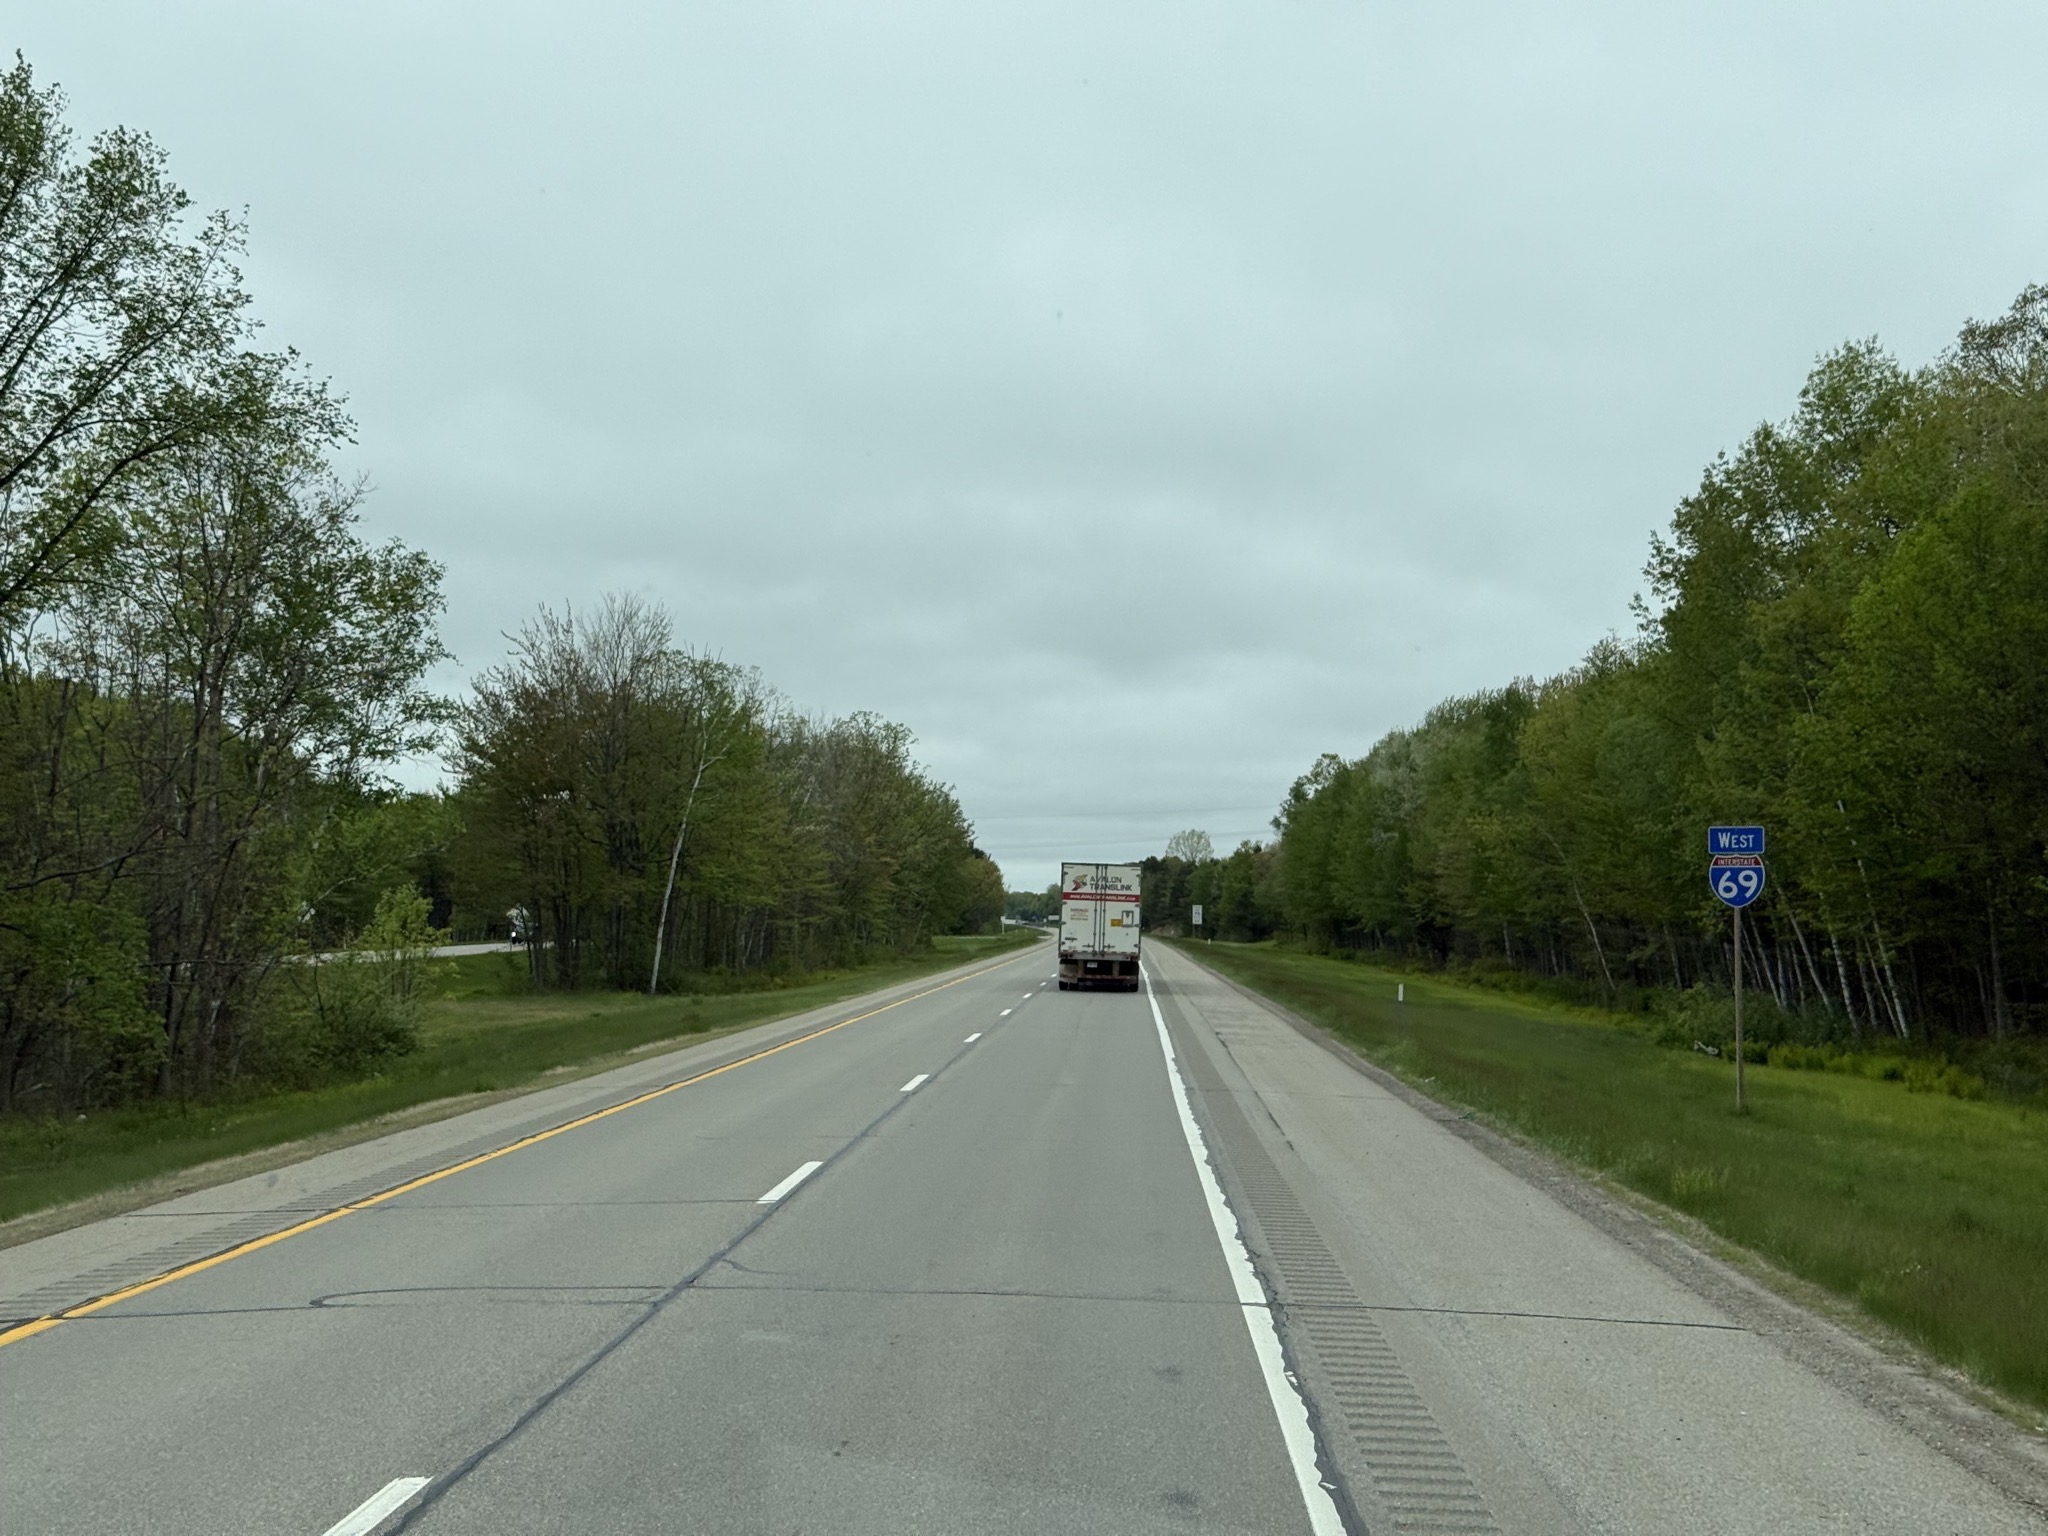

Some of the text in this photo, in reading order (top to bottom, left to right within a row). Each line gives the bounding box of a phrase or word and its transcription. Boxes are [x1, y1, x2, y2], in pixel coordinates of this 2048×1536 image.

[1718, 832, 1755, 848] WEST
[1717, 858, 1756, 866] INTERSTATE
[1089, 875, 1123, 884] AVALON
[1089, 883, 1133, 892] TRANSLINK
[1718, 870, 1758, 899] 69
